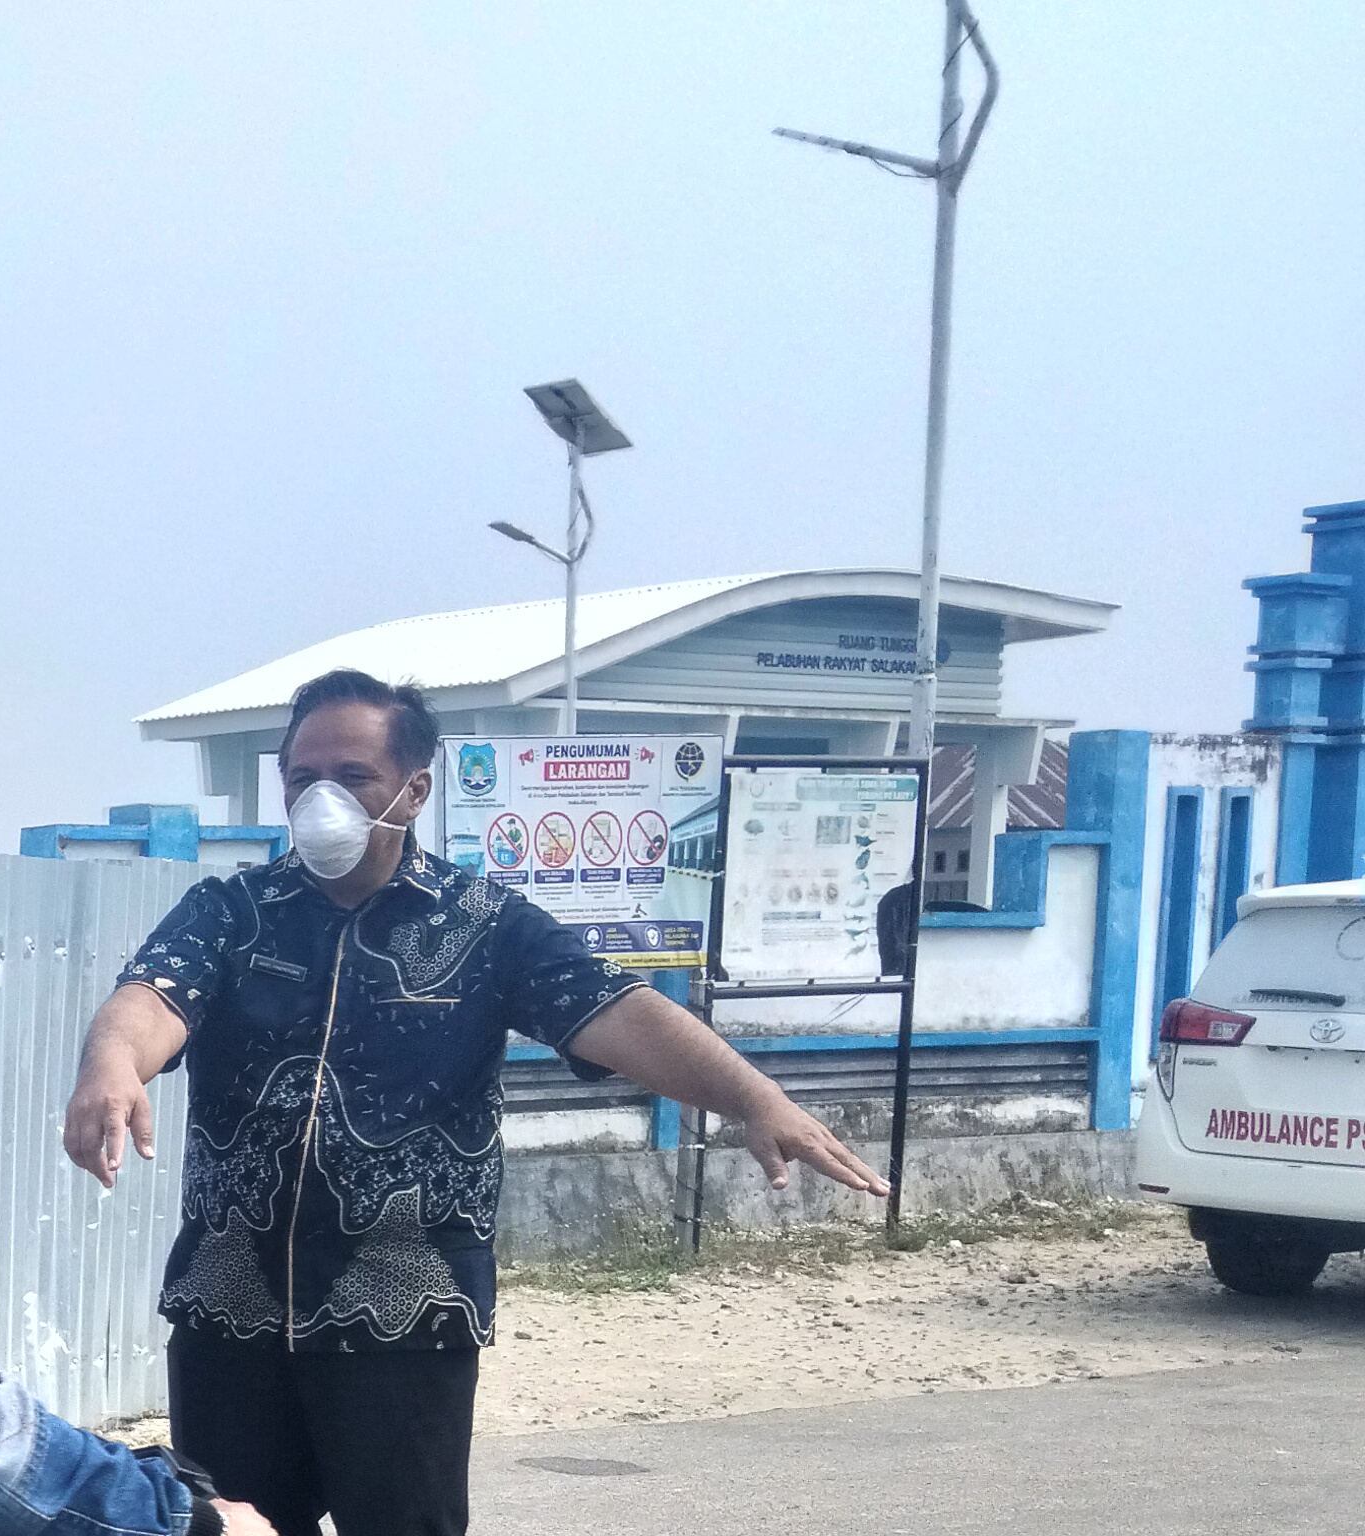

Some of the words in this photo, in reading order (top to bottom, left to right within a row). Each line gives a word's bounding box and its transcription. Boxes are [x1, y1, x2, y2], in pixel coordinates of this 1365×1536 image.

[838, 634, 875, 651] RUANG
[756, 652, 820, 670] PELABUHAN
[823, 655, 867, 673] RAKYAT
[545, 744, 631, 759] PENGUMUMAN
[548, 762, 628, 780] LARANGAN
[1205, 1108, 1339, 1149] AMBULANCE
